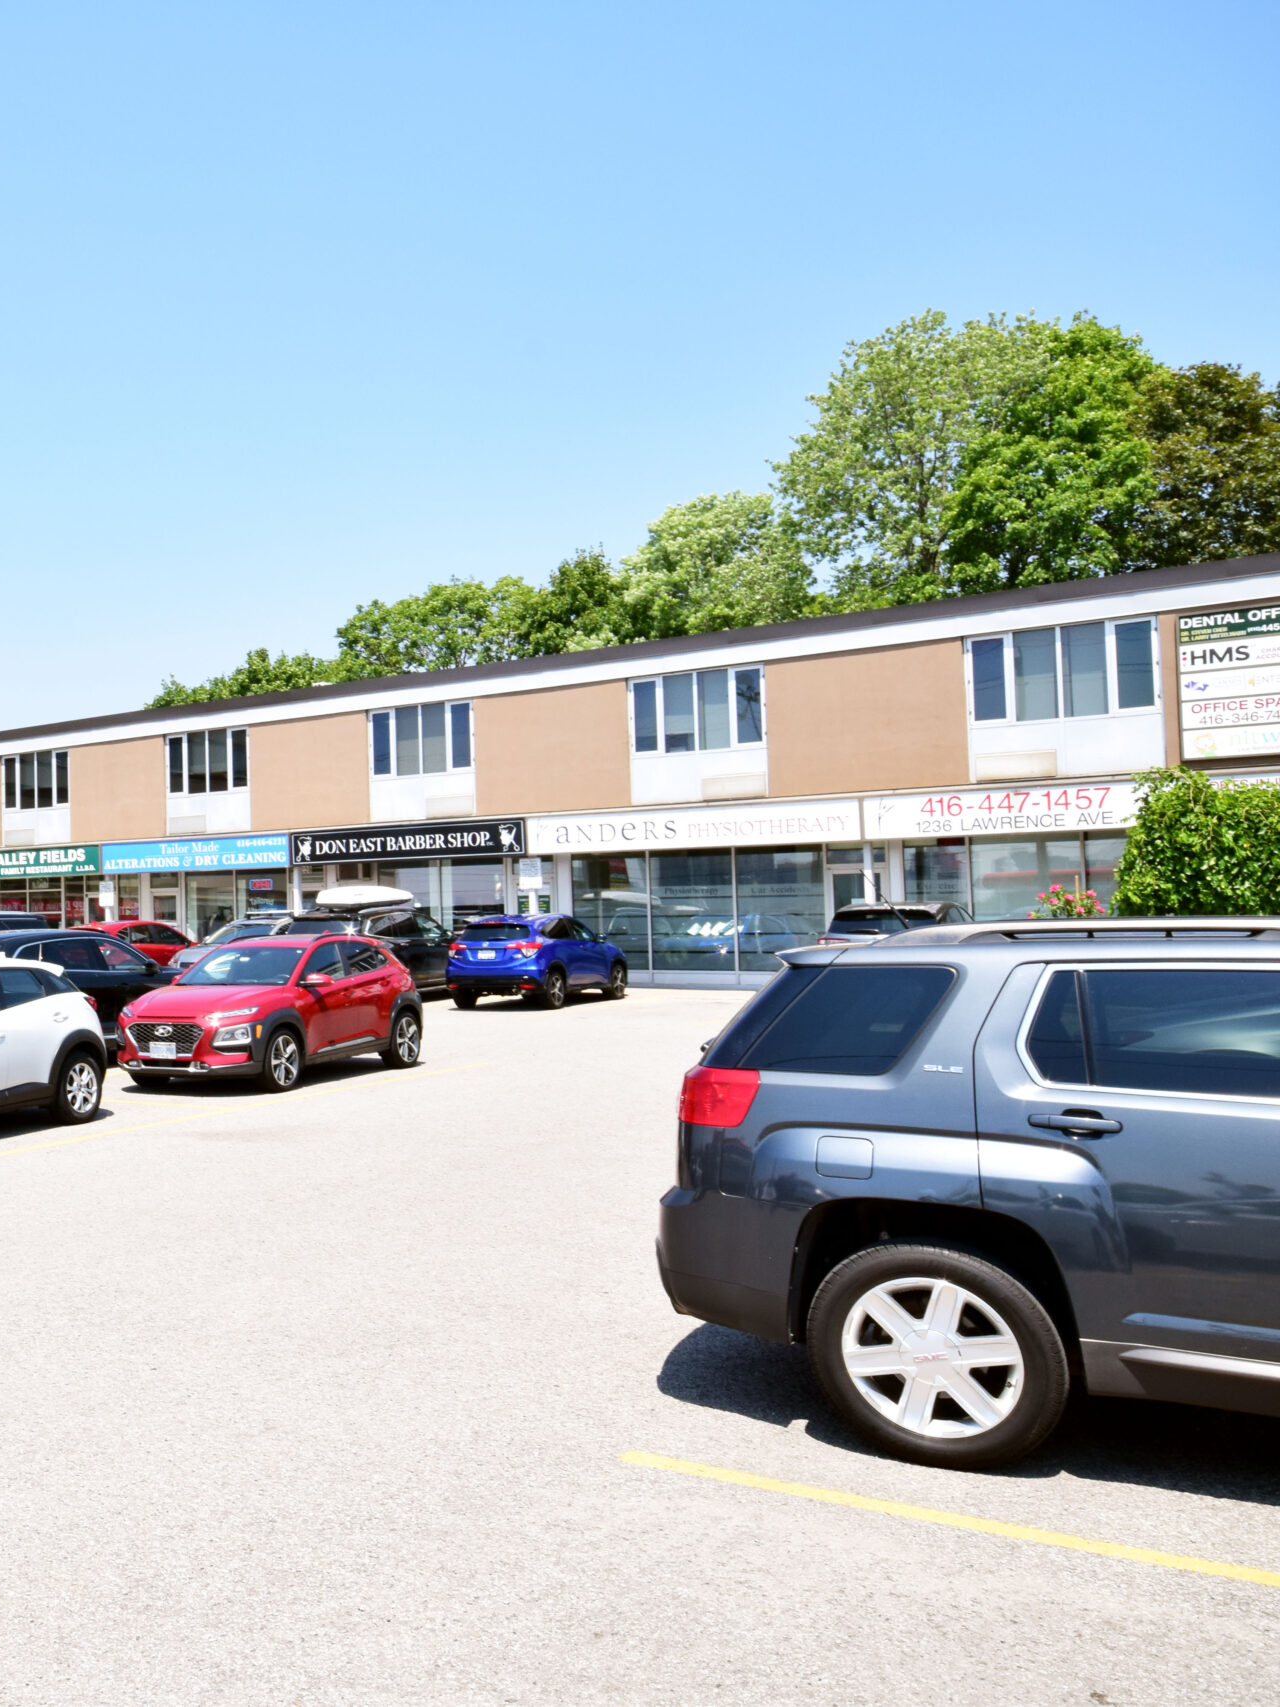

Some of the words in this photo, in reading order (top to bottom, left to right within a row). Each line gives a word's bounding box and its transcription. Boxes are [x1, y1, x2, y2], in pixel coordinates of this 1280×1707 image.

[1180, 612, 1244, 630] DENTAL
[1247, 607, 1280, 622] OFF
[1191, 699, 1249, 714] OFFICE
[1254, 697, 1280, 710] SPA
[1199, 710, 1280, 726] 416-346-74
[1229, 729, 1280, 747] nitw
[920, 787, 1111, 817] 416-447-1457
[687, 815, 849, 839] PHYSIOTHERAPY
[915, 819, 952, 833] 1236
[961, 813, 1065, 832] LAWRENCE
[1076, 811, 1119, 826] AVE.
[159, 843, 189, 855] Tailor
[191, 840, 219, 853] Made
[315, 839, 347, 855] DON
[349, 836, 385, 853] EAST
[386, 833, 446, 851] BARBER
[447, 831, 490, 848] SHOP
[39, 849, 86, 864] FIELDS
[104, 855, 180, 870] ALTERATIONS
[194, 855, 218, 866] DRY
[222, 851, 286, 865] CLEANING
[0, 866, 24, 876] FAMILY
[25, 864, 73, 874] RESTAURANT
[923, 1064, 964, 1074] SLE
